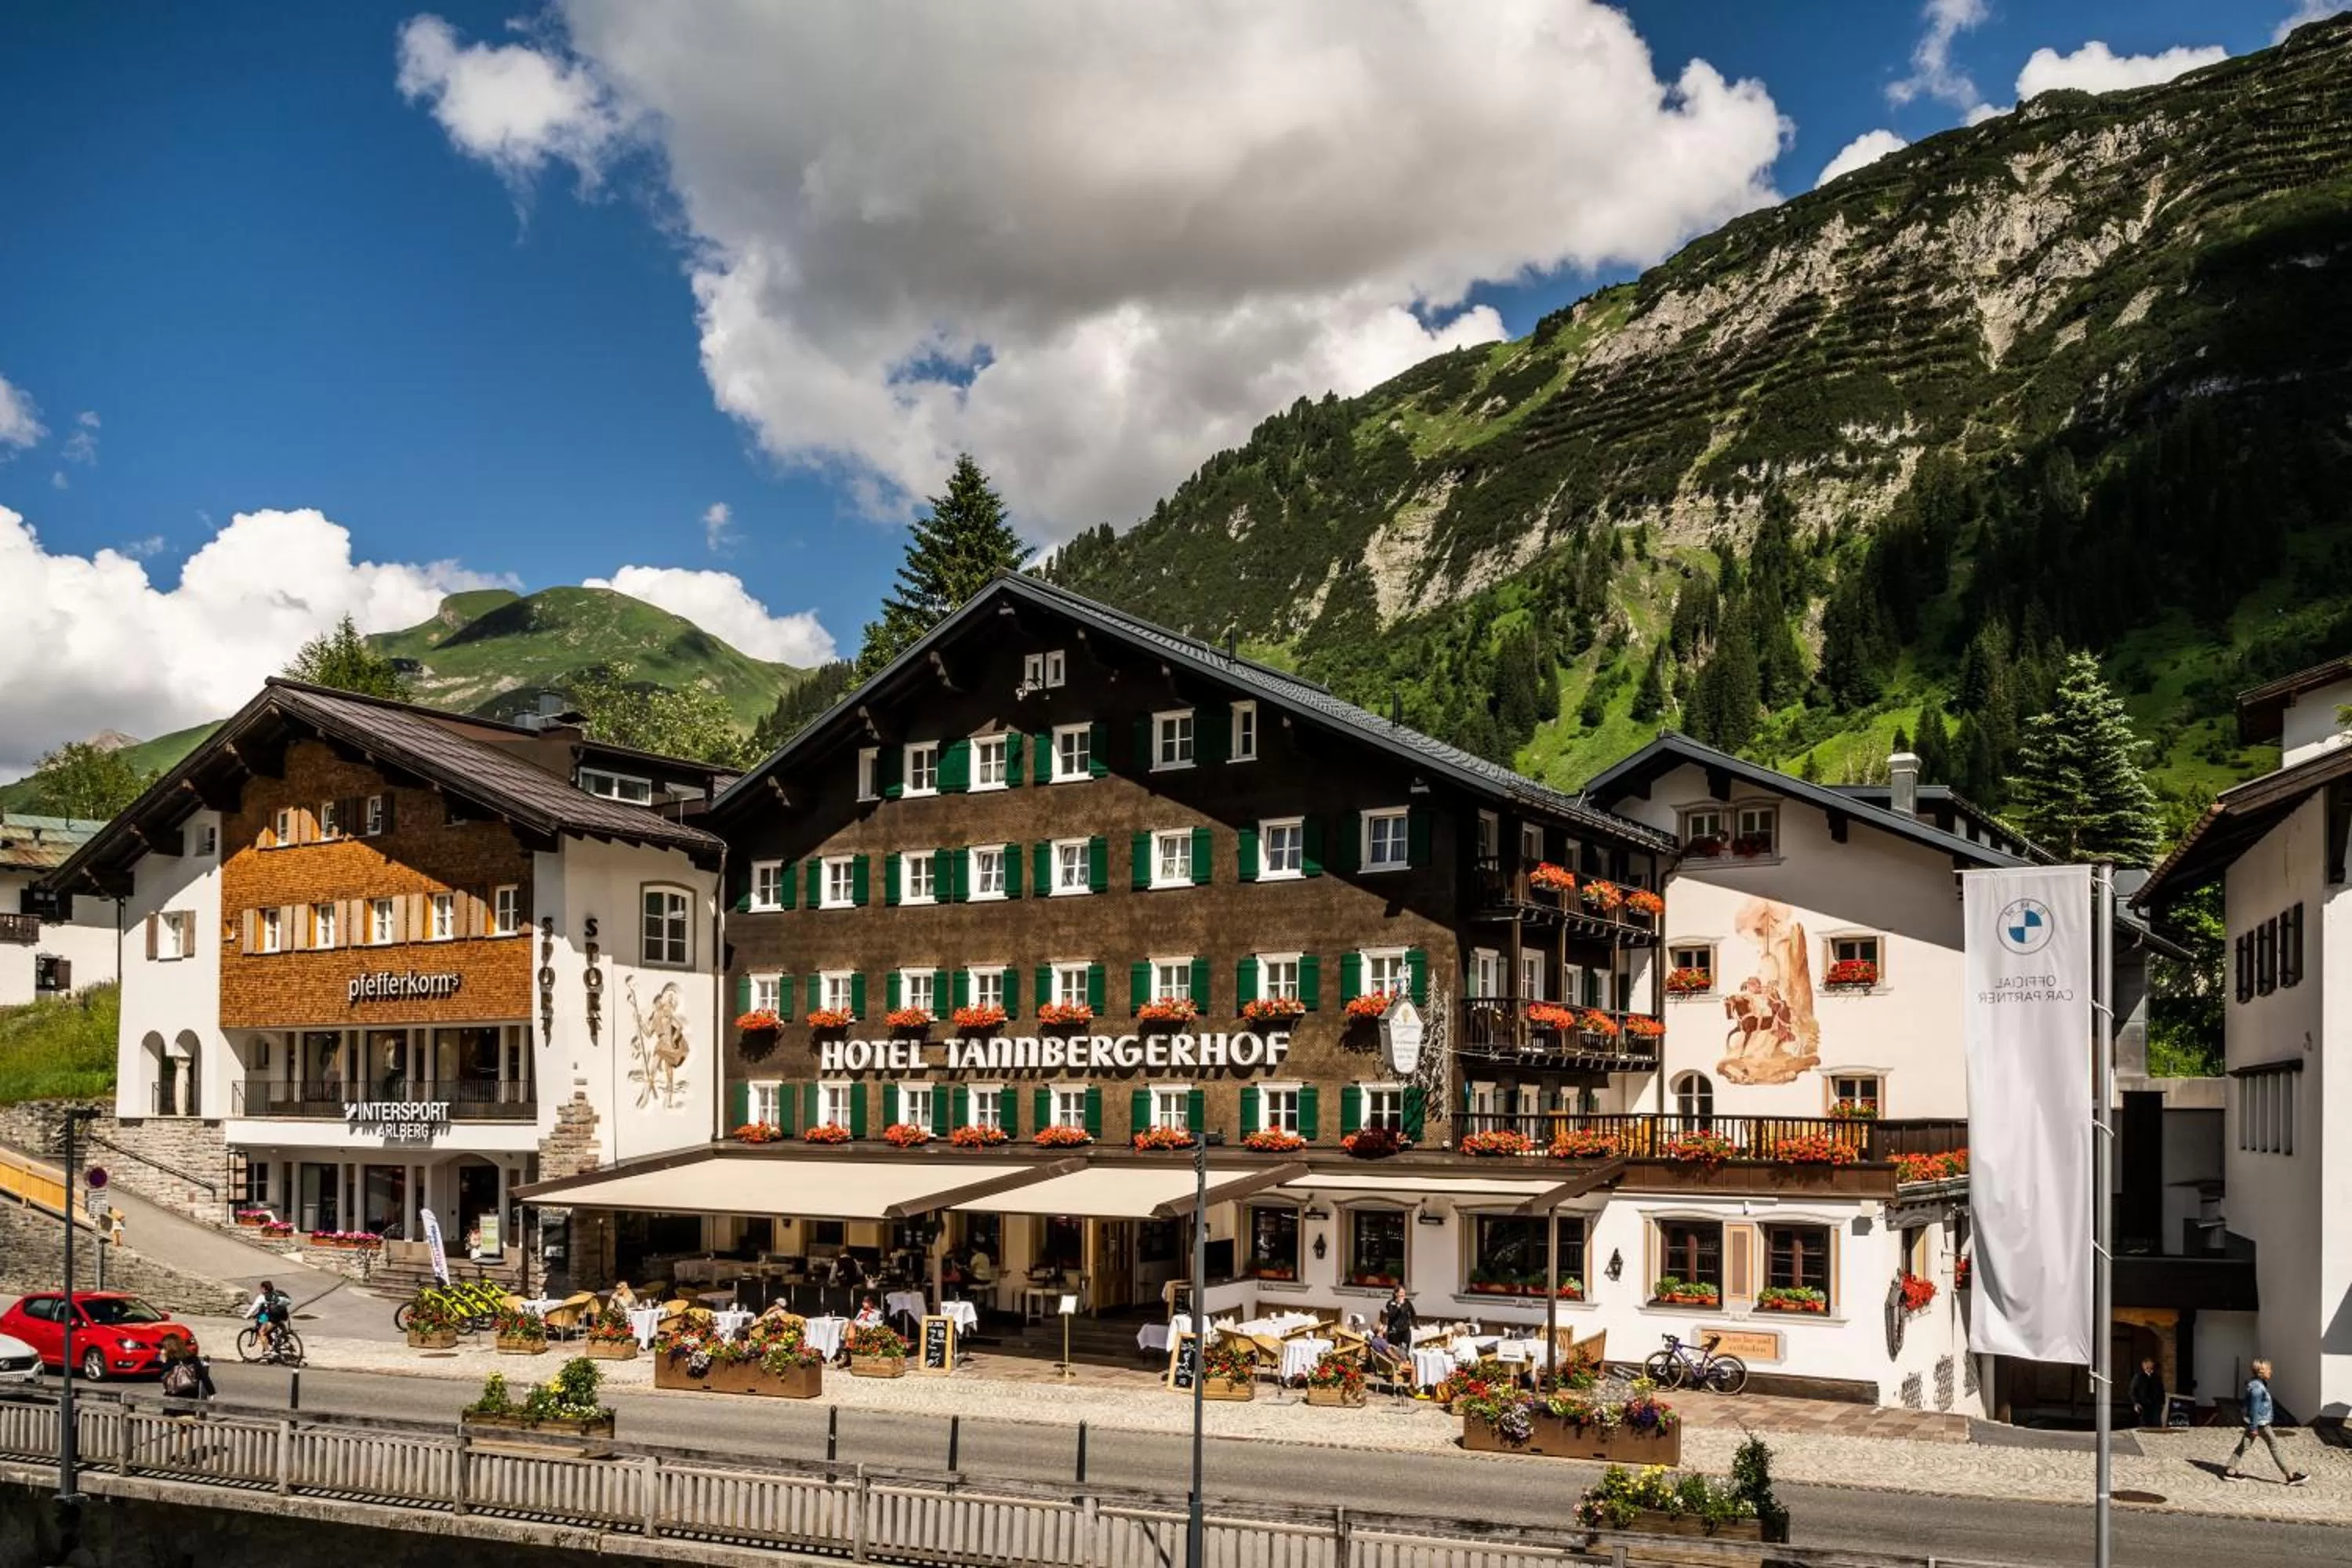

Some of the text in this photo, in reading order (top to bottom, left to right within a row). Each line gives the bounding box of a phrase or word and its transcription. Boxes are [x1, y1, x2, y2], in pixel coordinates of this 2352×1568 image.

[348, 970, 459, 1000] pfefferkorn's
[537, 916, 555, 1036] SPORT
[583, 918, 602, 1036] SPORT
[821, 1031, 1290, 1070] HOTEL TANNBERGERHOF
[358, 1102, 449, 1120] INTERSPORT
[377, 1123, 429, 1138] ARLBERG
